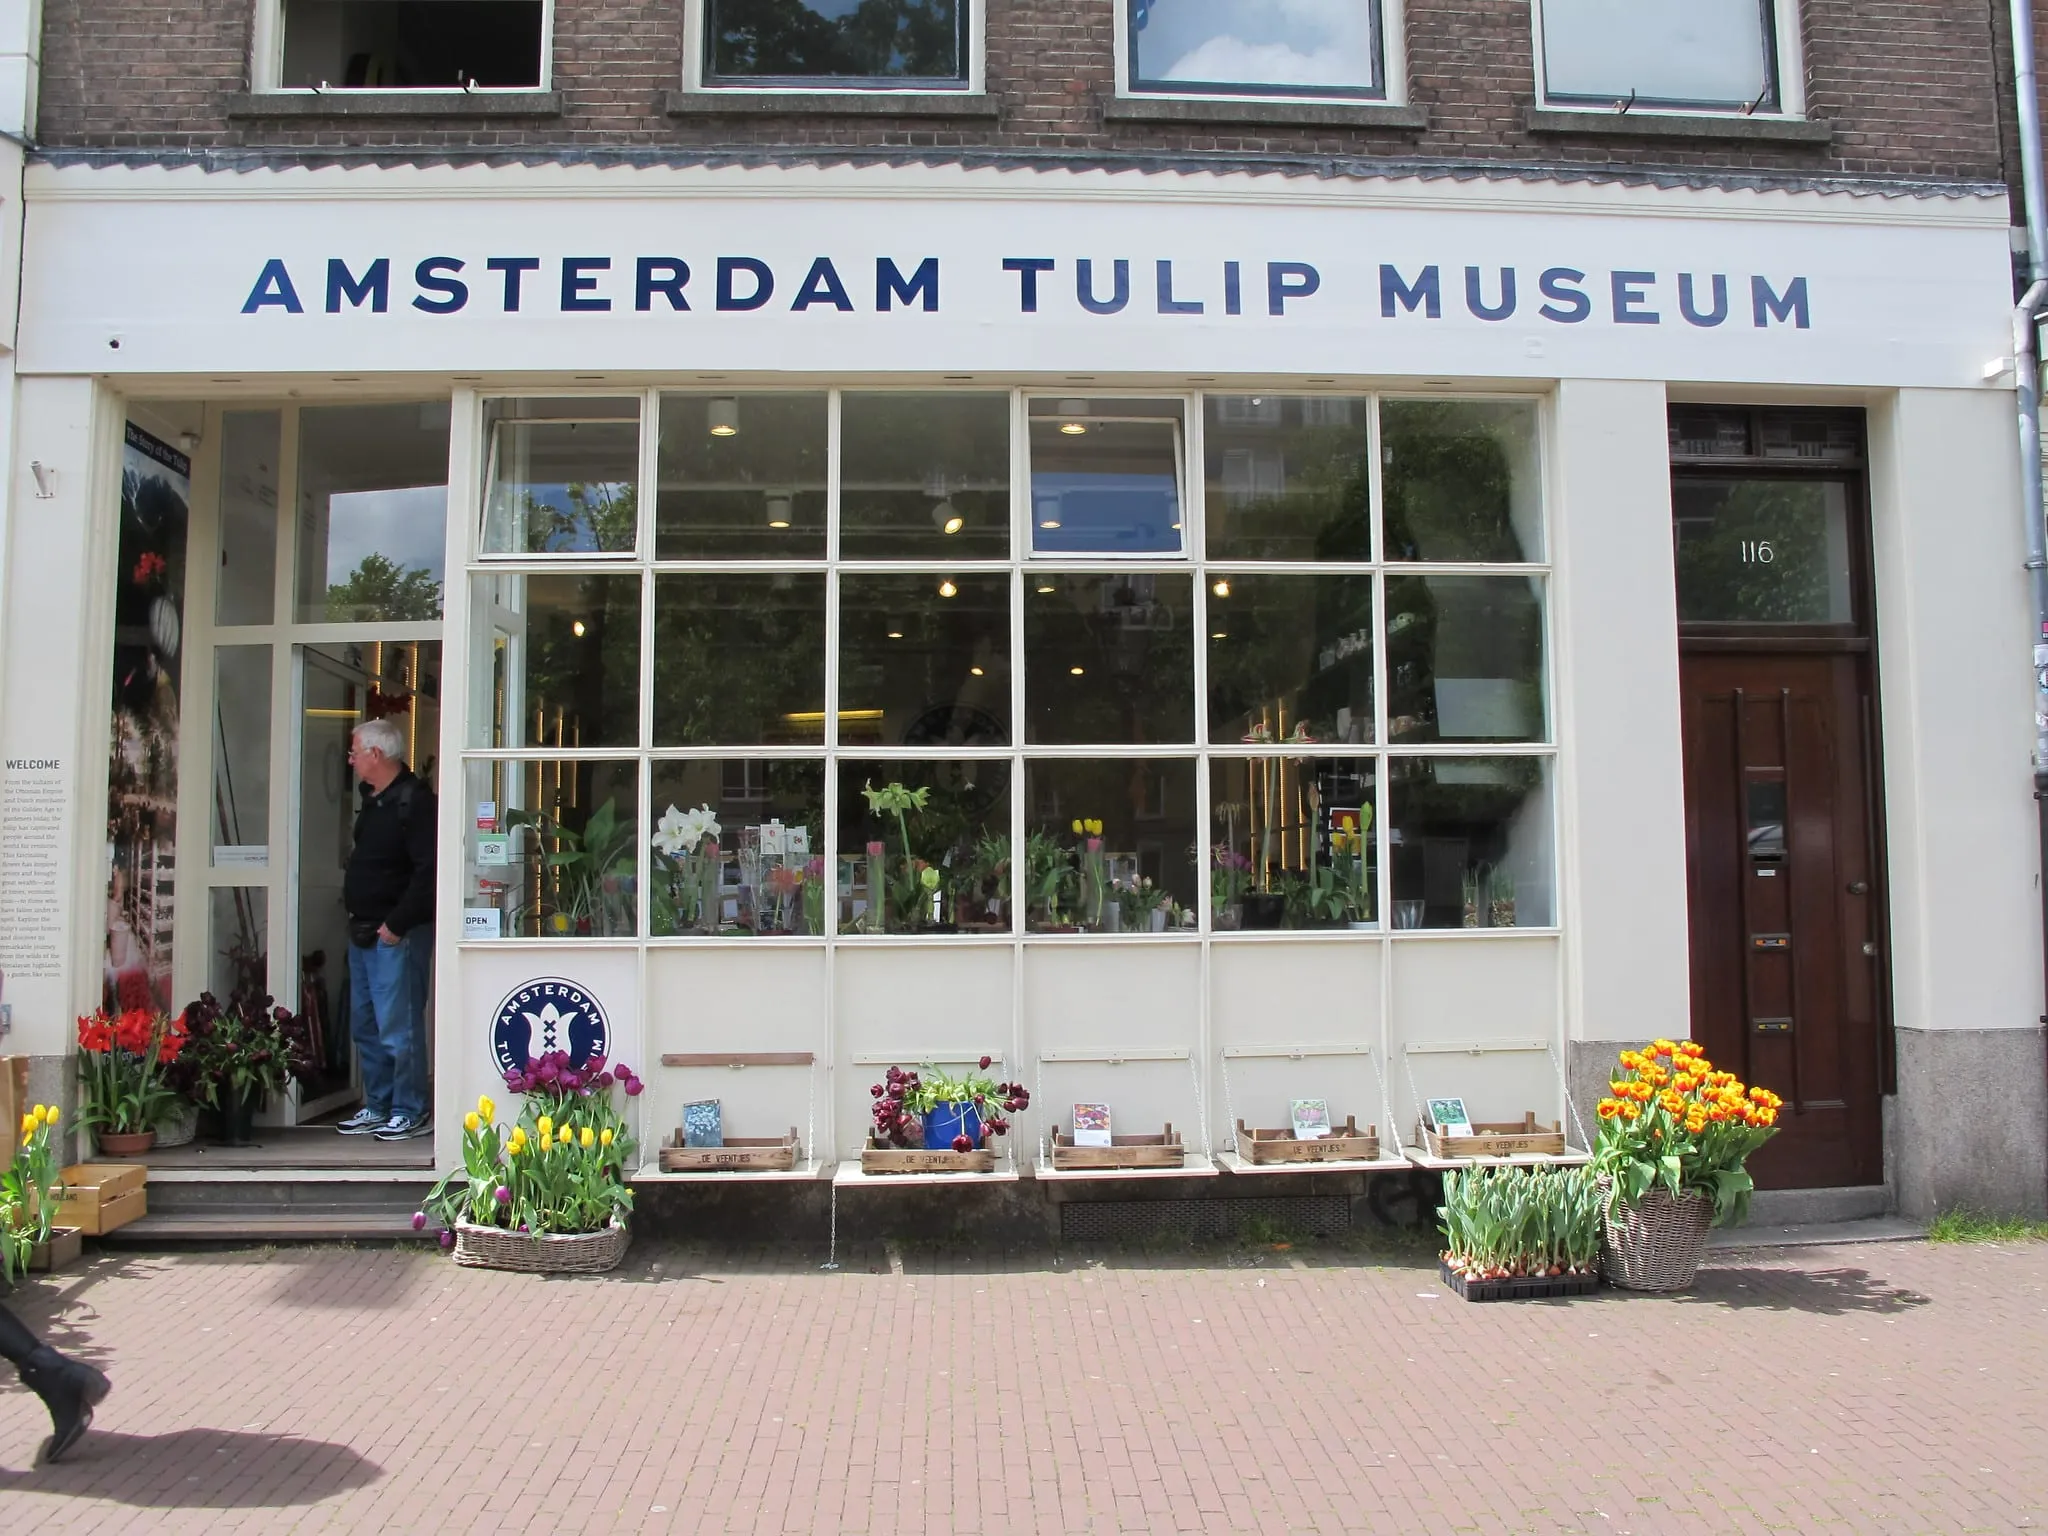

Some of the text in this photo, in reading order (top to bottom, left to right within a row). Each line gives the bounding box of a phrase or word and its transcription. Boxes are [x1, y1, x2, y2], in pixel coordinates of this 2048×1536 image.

[239, 256, 1810, 330] AMSTERDAM TULIP MUSEUM
[127, 426, 187, 472] The Story of the Tulip
[1741, 540, 1774, 564] 116
[6, 760, 60, 770] WELCOME
[466, 917, 488, 925] OPEN
[501, 984, 600, 1026] AMSTERDAM
[702, 1154, 711, 1163] DE
[905, 1155, 915, 1164] DE
